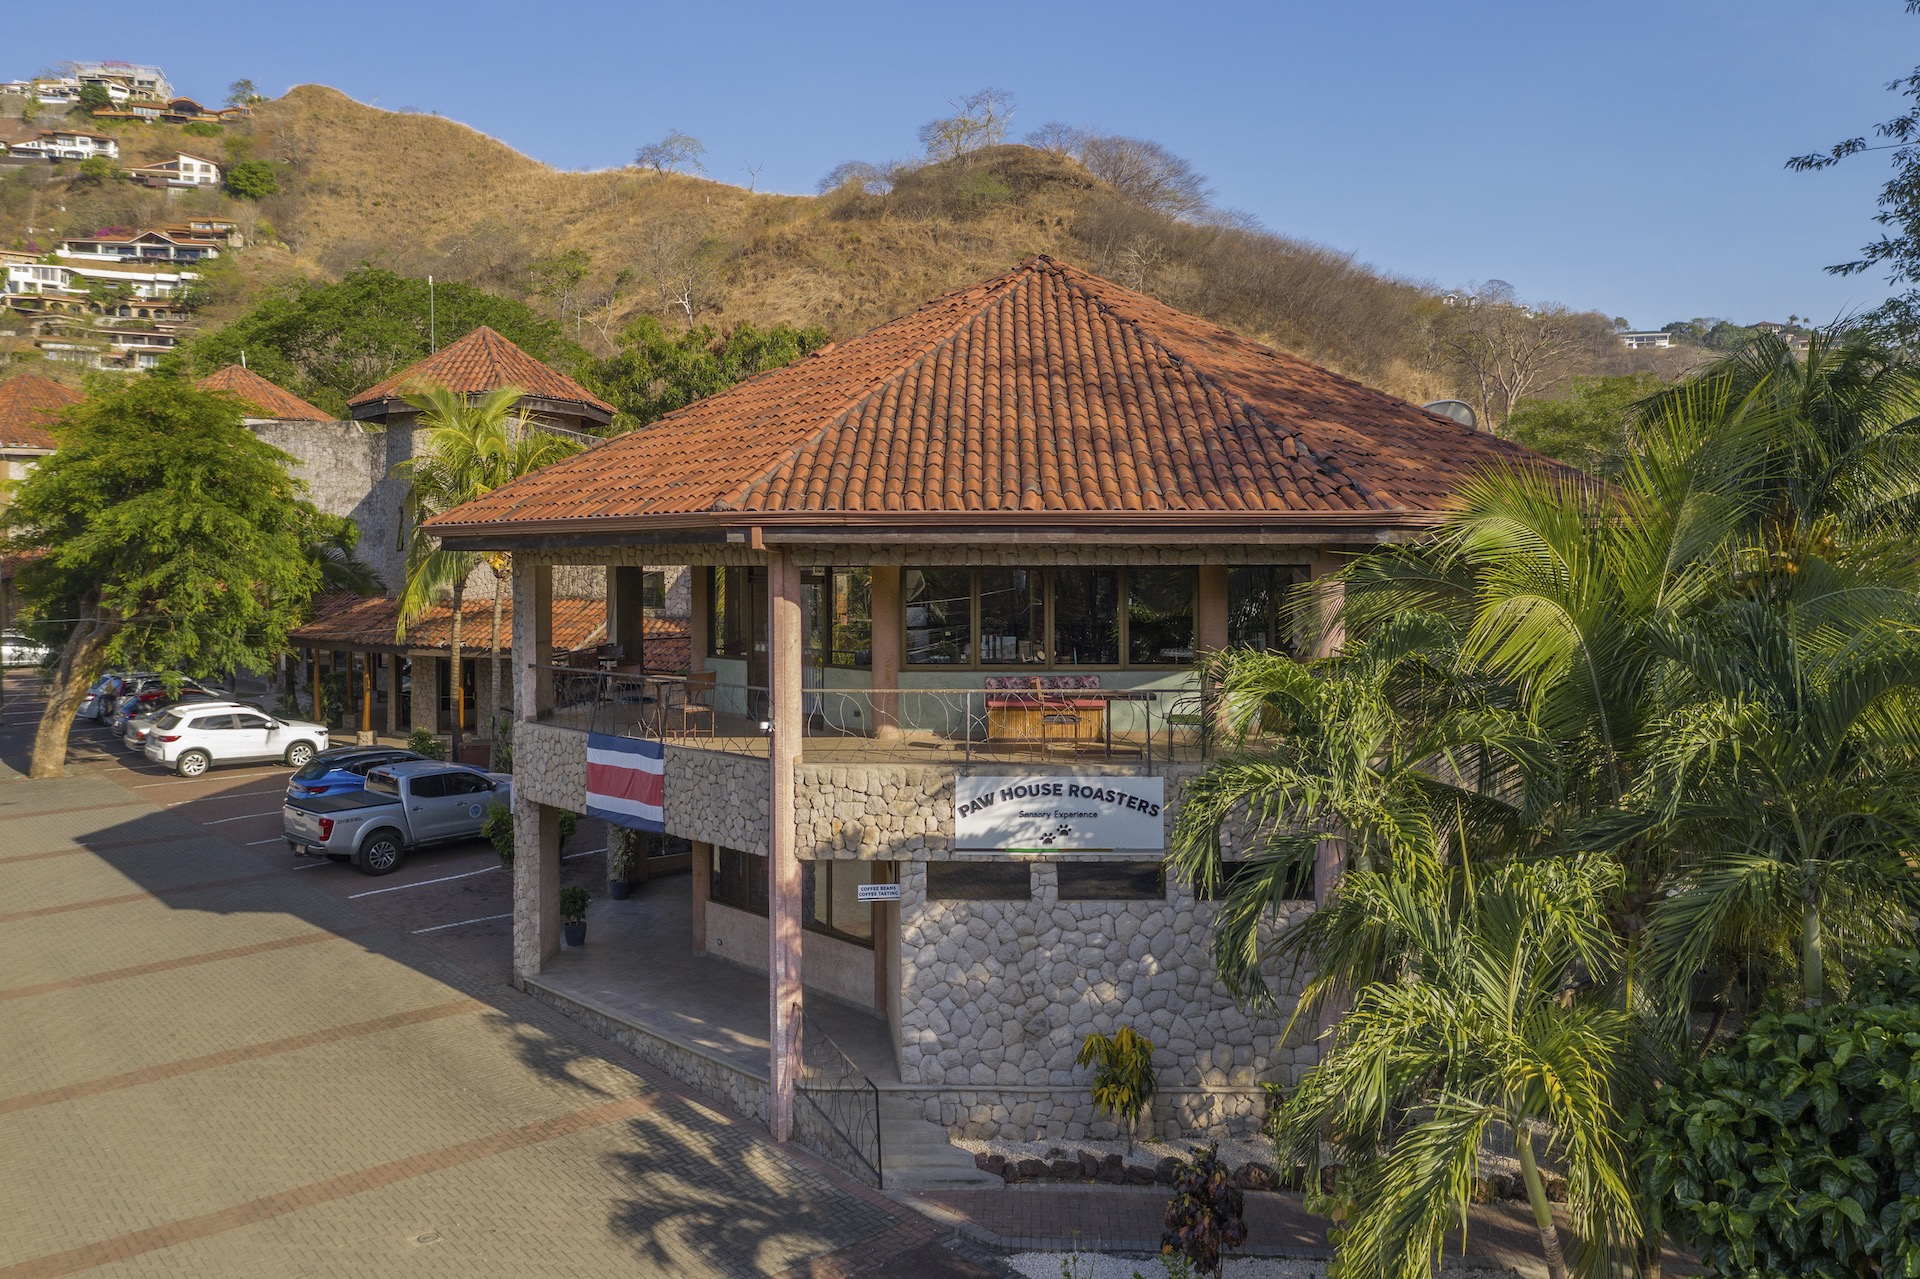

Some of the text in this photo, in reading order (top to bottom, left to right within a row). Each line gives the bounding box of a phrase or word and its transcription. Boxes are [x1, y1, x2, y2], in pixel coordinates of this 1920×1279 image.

[957, 783, 1160, 819] PAW HOUSE ROASTERS
[1018, 810, 1098, 820] Sensory Experience
